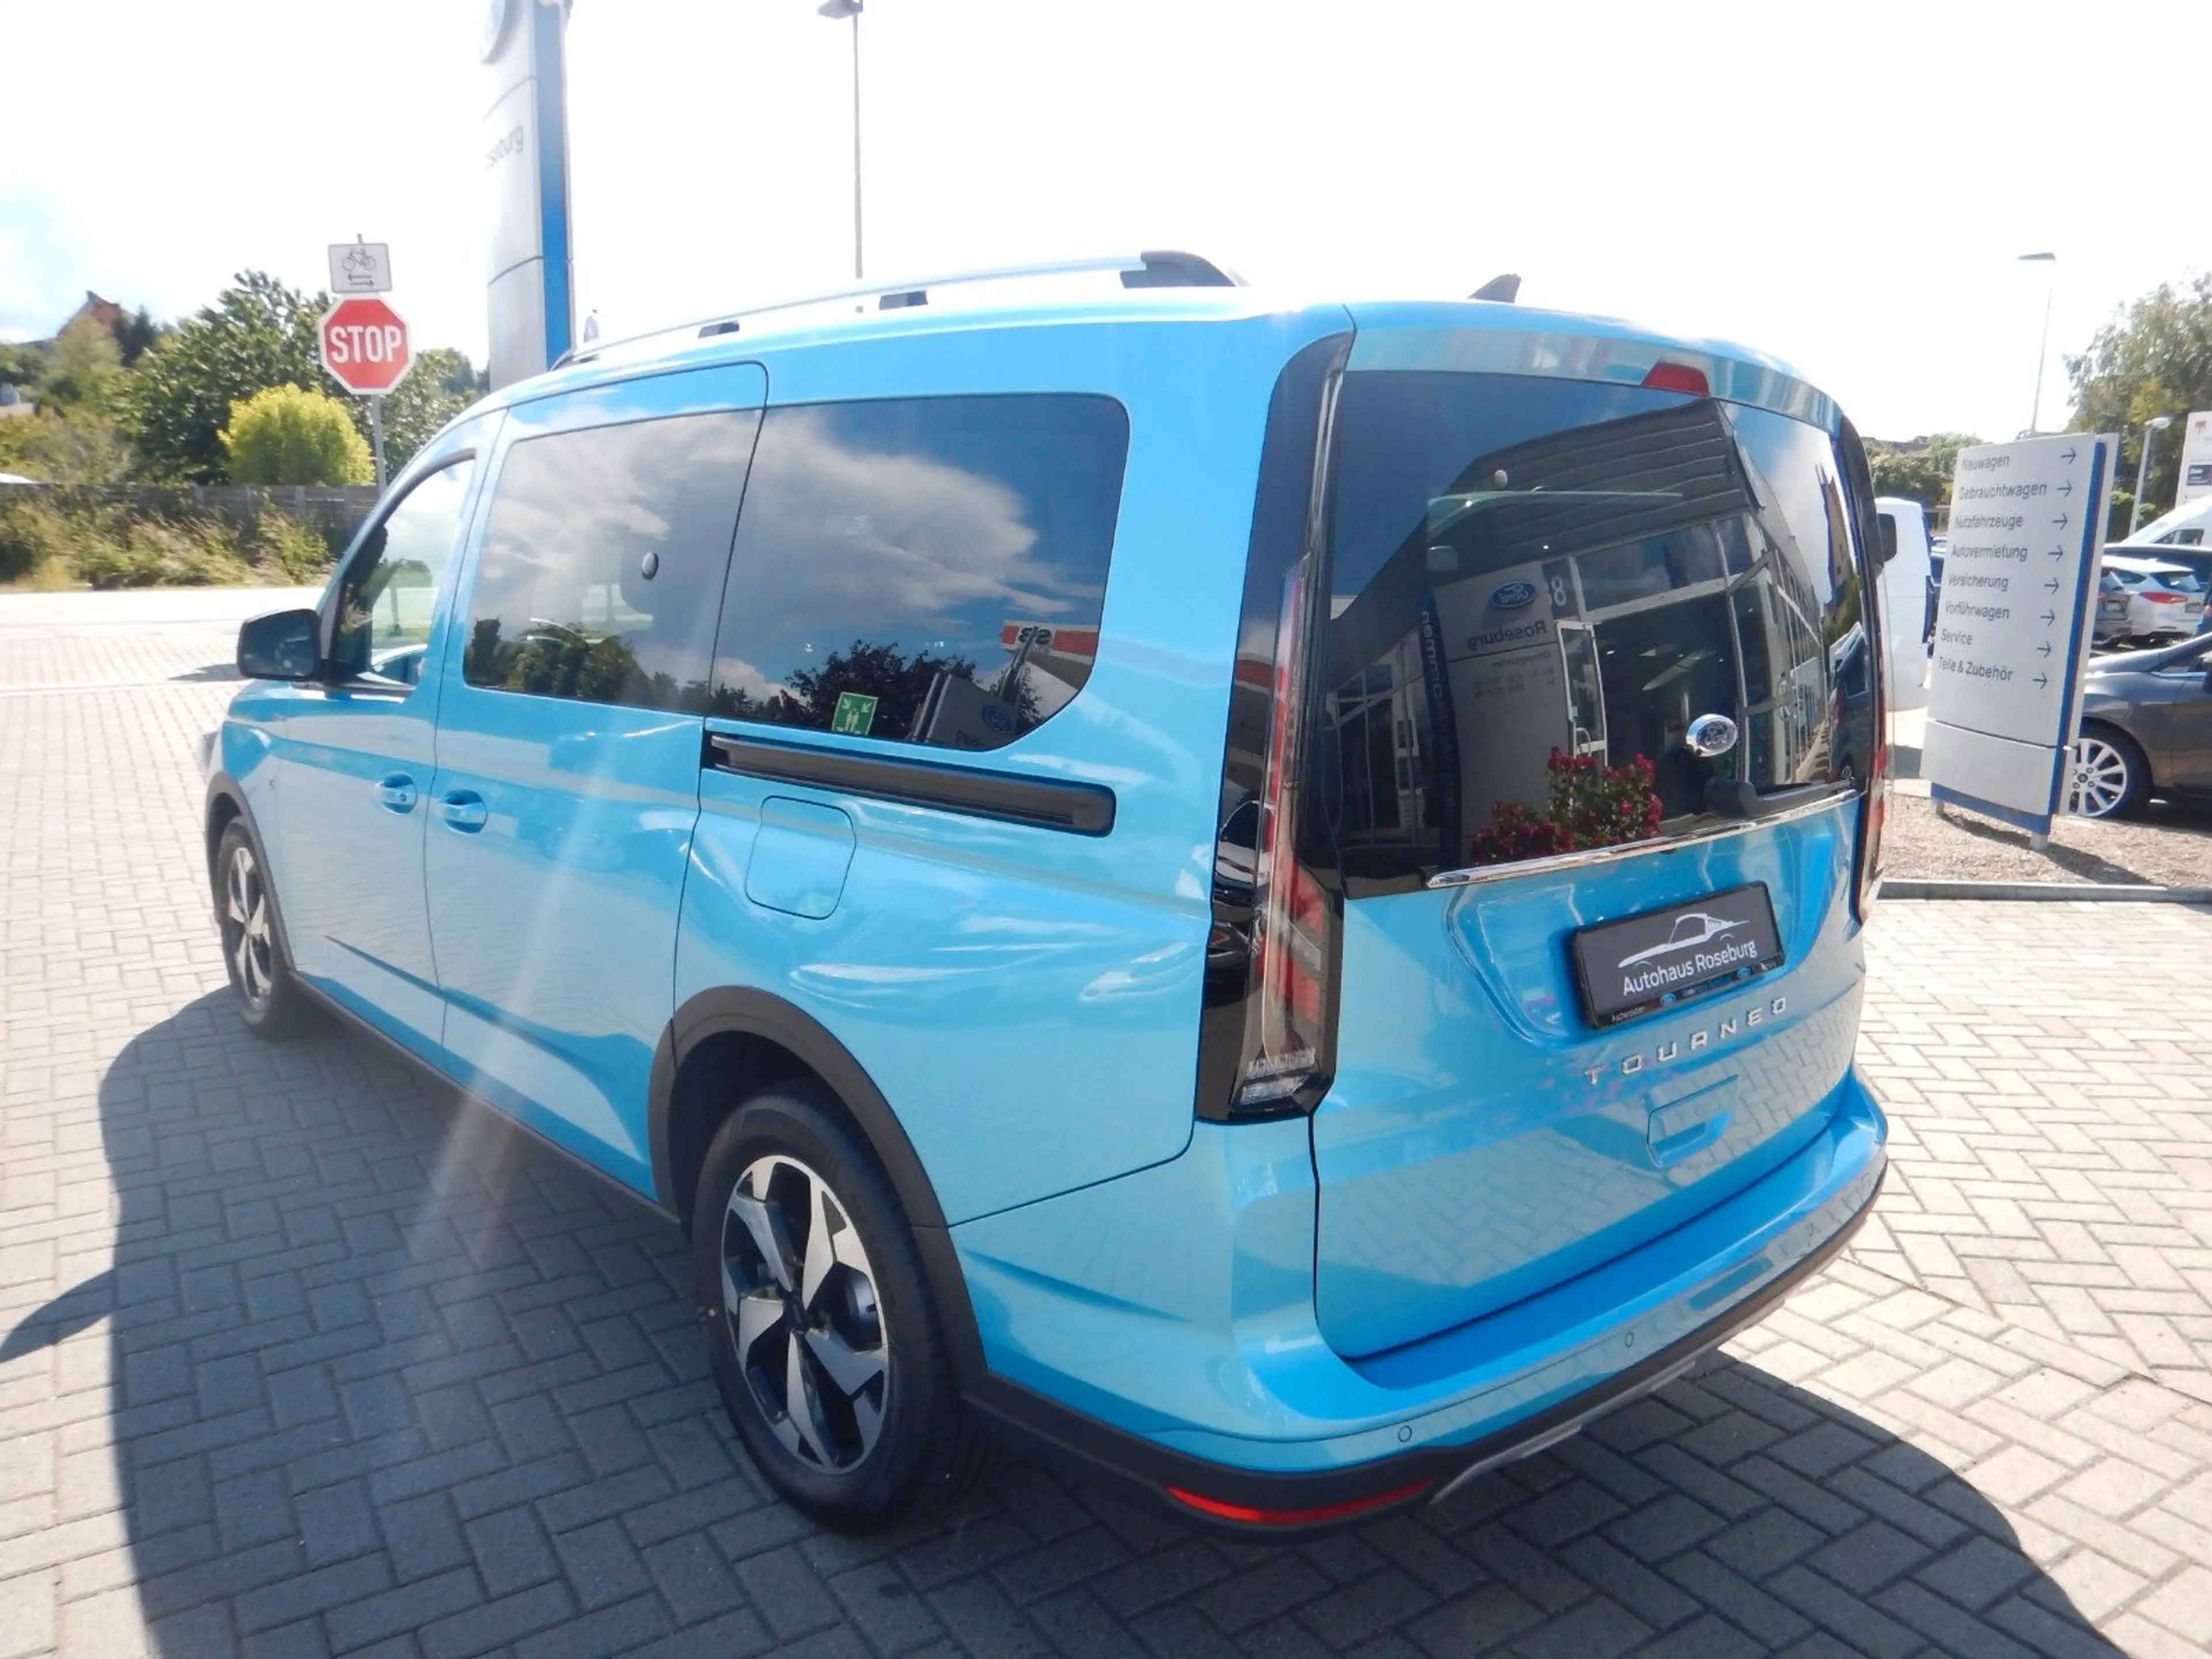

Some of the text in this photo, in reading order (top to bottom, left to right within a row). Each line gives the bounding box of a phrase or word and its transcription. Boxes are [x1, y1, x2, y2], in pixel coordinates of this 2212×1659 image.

[329, 325, 402, 363] STOP
[1962, 456, 2010, 471] Neuwagen
[1958, 483, 2047, 500] Gebrauchtwagen
[1955, 514, 2024, 531] Nutzfahrzeuge
[1951, 543, 2028, 562] Autovermietung
[1948, 572, 2009, 592] Versicherung
[1945, 599, 2010, 622] Vorführwagen
[1941, 628, 1973, 646] Service
[1939, 656, 2014, 682] Teile & Zubehör
[1623, 940, 1758, 996] Autohaus Roseburg
[1584, 995, 1786, 1085] TOURNEO
